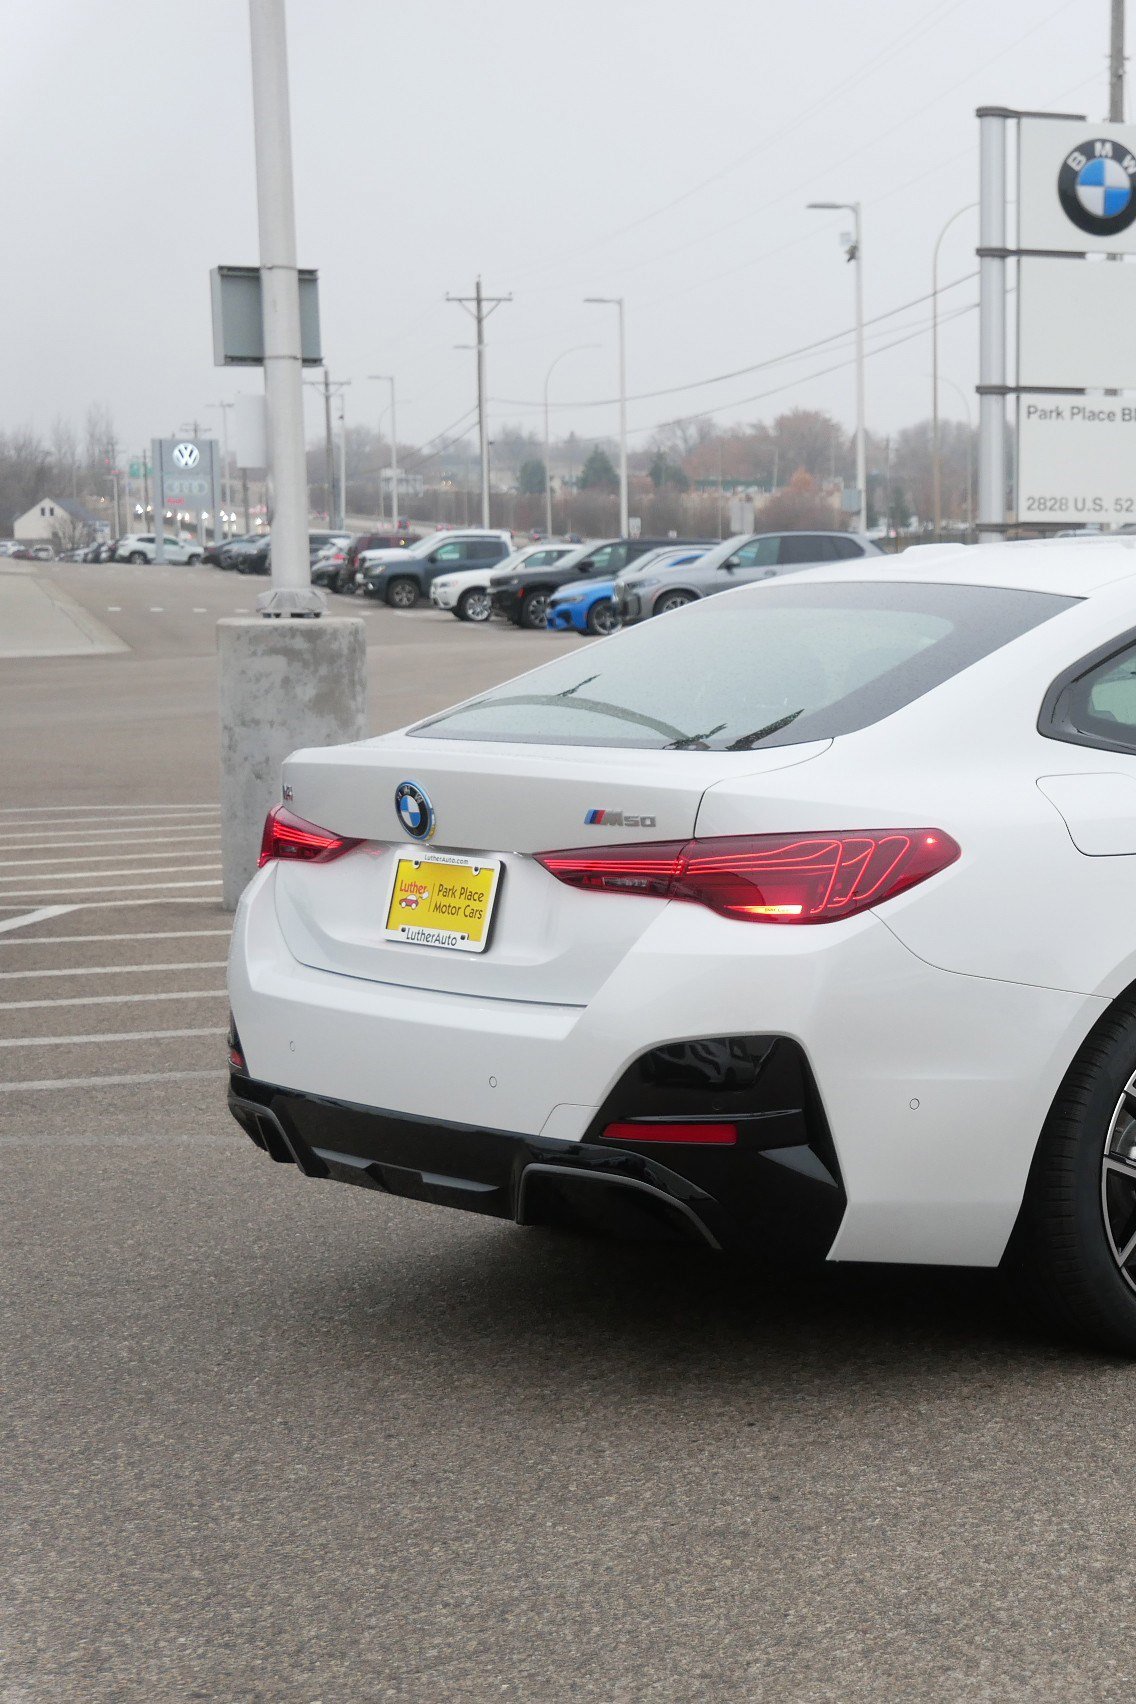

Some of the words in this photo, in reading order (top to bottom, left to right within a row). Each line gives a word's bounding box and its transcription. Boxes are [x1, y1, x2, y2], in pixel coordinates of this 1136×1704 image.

[1026, 404, 1065, 421] Park
[1070, 406, 1116, 422] Place
[174, 443, 200, 470] VW
[1026, 496, 1069, 512] 2828
[1074, 497, 1109, 512] U.S.
[1113, 498, 1135, 513] 52
[424, 853, 469, 866] LutherAuto.com
[400, 879, 429, 896] Luther
[437, 883, 457, 900] Park
[458, 886, 485, 903] Place
[432, 900, 462, 917] Motor
[463, 904, 483, 920] Cars
[405, 927, 458, 947] LutherAuto
